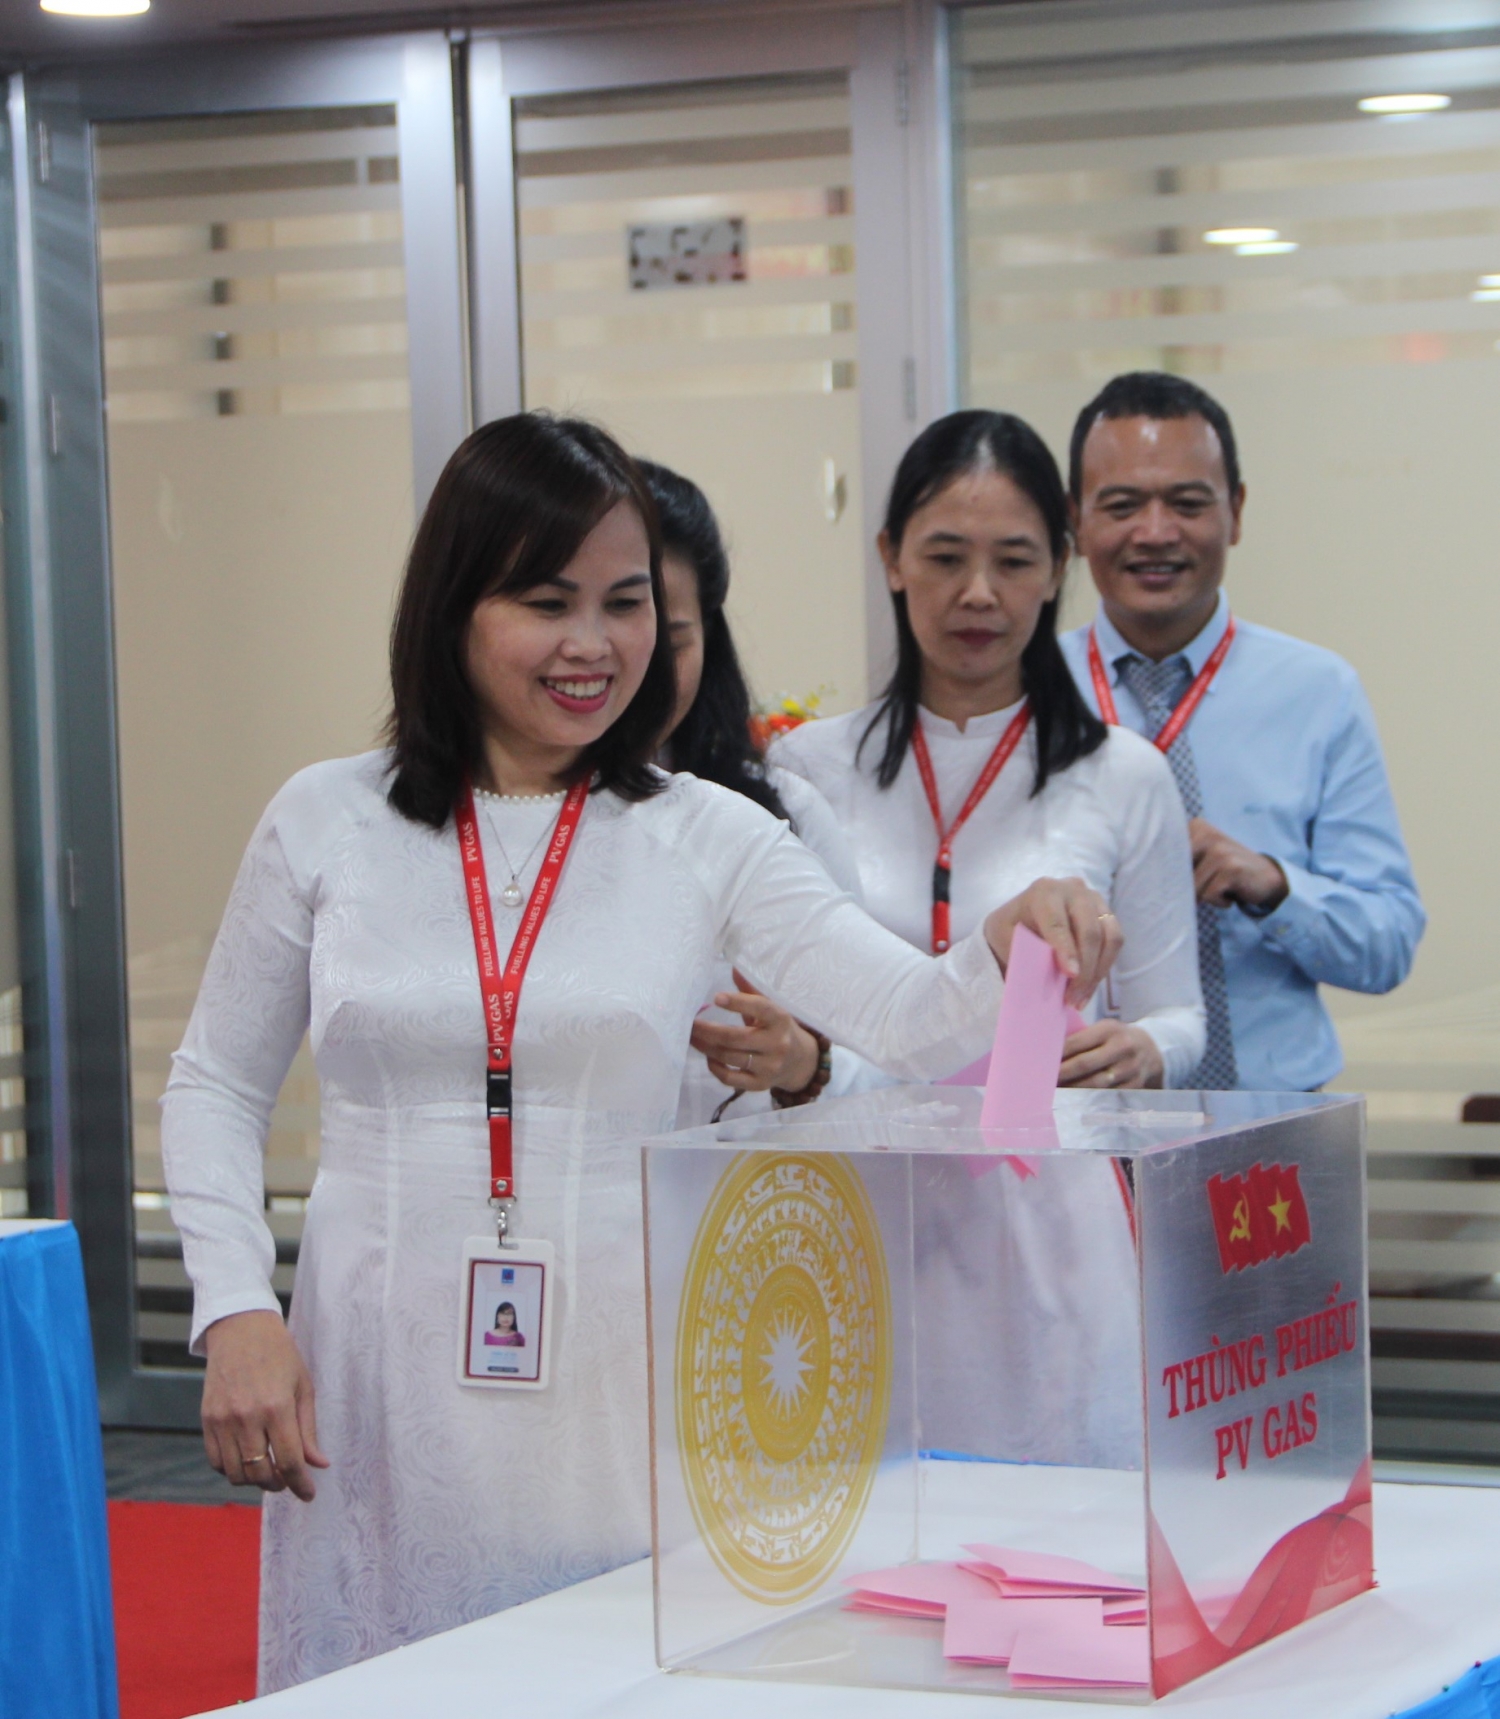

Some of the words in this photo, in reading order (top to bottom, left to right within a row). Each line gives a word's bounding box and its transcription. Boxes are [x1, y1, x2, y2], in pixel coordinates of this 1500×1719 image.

[462, 822, 477, 847] GAS
[549, 847, 562, 863] PV
[556, 824, 571, 847] GAS
[466, 847, 478, 862] PV
[472, 876, 482, 894] LIFE
[474, 894, 483, 905] TO
[476, 905, 488, 936] VALUES
[510, 936, 530, 975] FUELLING
[524, 905, 541, 935] VALUES
[535, 894, 545, 905] TO
[542, 876, 551, 894] LIFE
[480, 936, 494, 977] FUELLING
[488, 993, 502, 1022] GAS
[492, 1022, 505, 1042] PV
[1162, 1334, 1267, 1419] THÙNG
[1275, 1281, 1357, 1378] PHIẾU
[1215, 1416, 1253, 1480] PV
[1263, 1392, 1318, 1459] GAS
